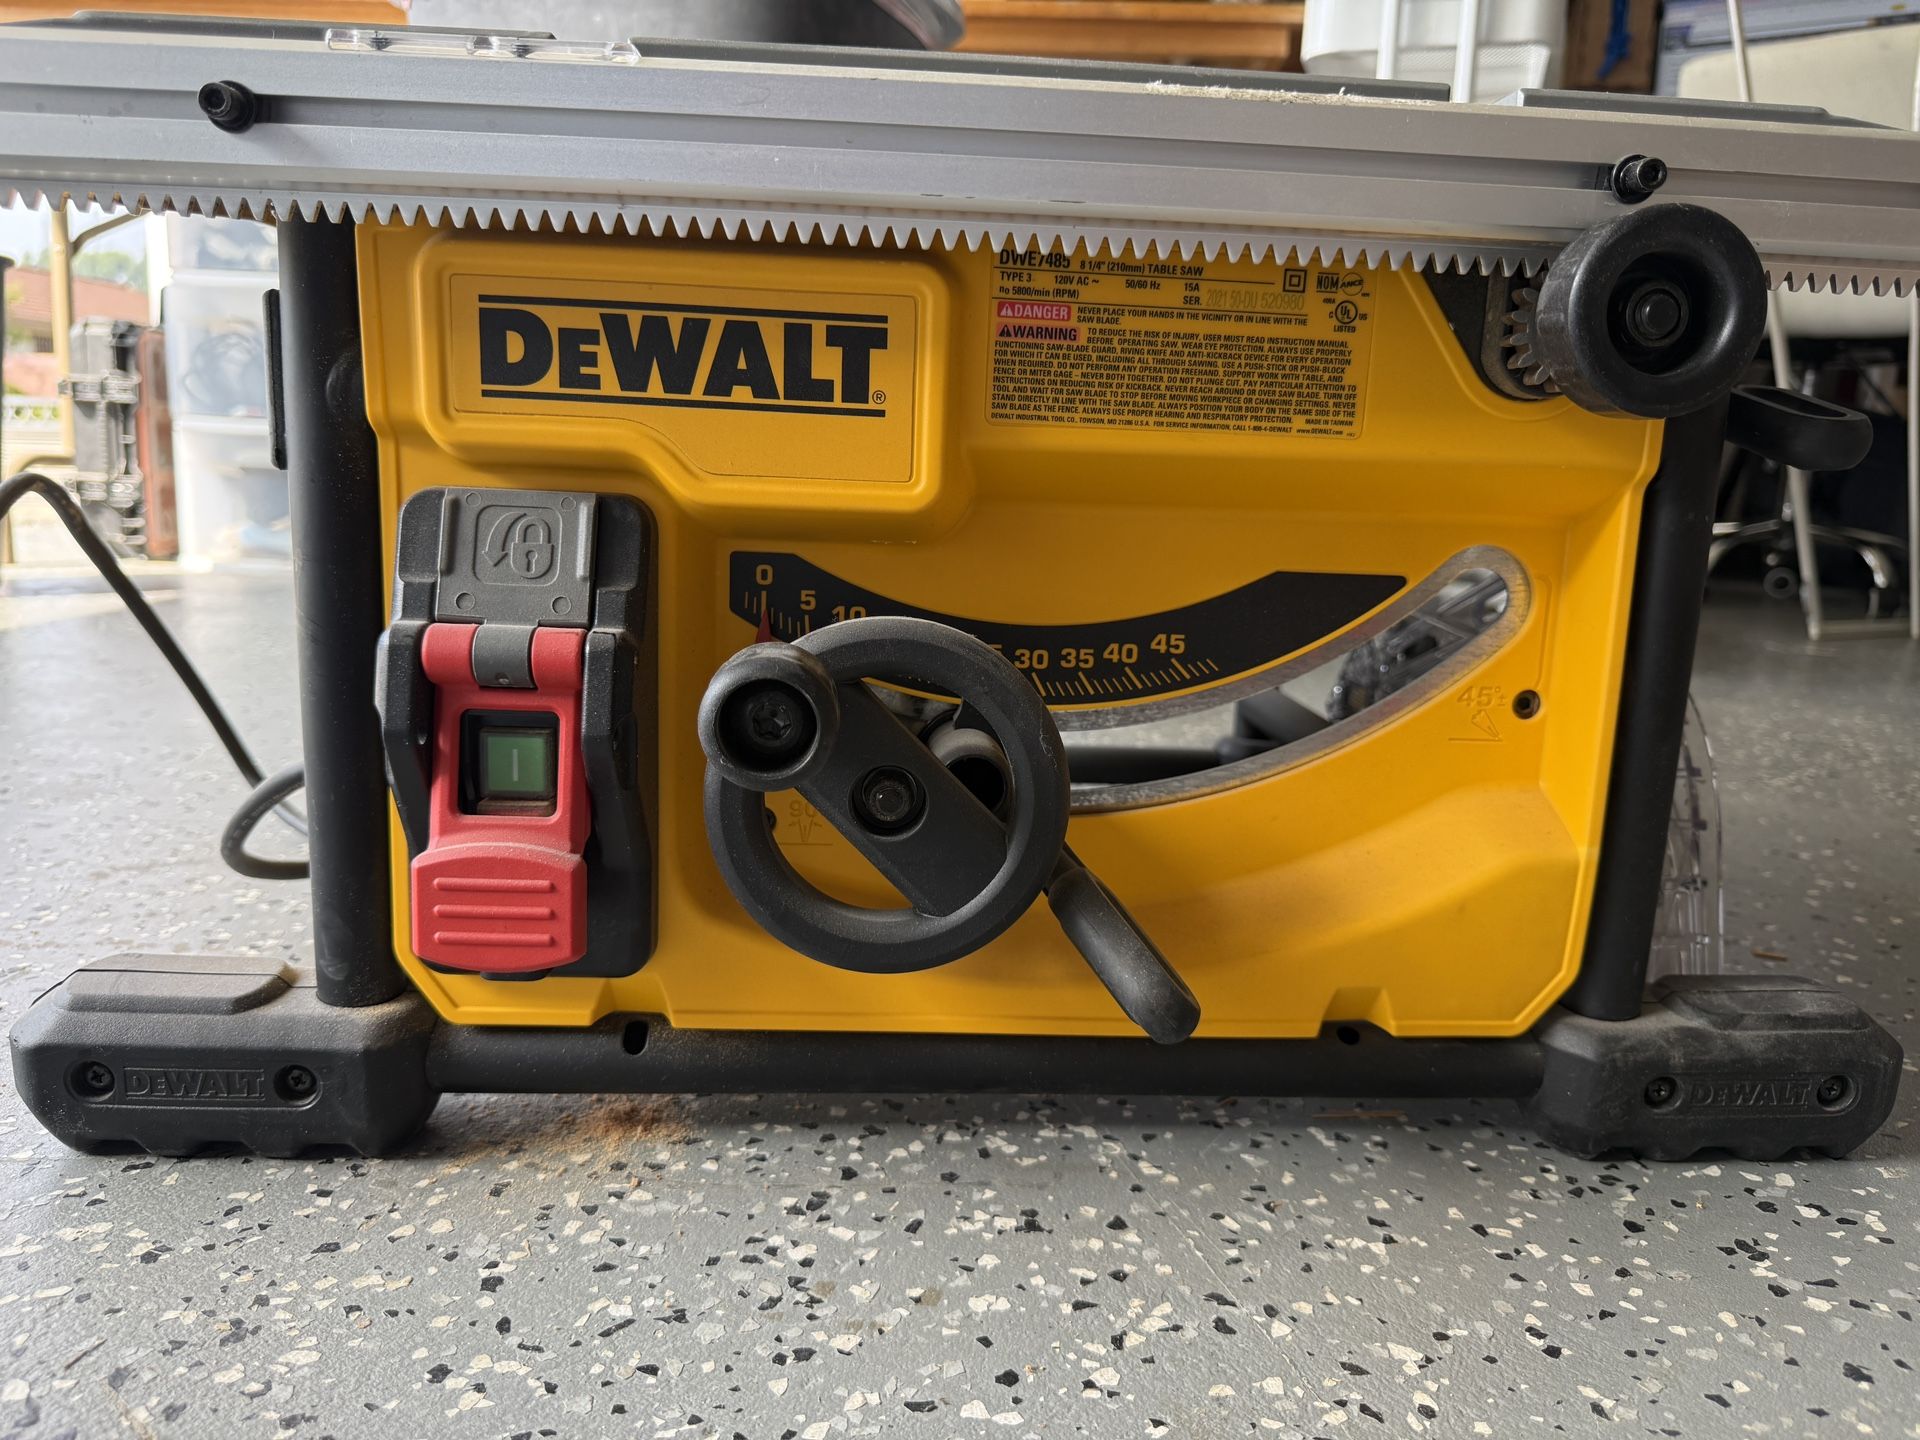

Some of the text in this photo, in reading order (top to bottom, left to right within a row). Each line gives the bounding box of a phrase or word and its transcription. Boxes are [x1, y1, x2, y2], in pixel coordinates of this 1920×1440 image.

[999, 271, 1031, 282] TYPE 3
[1079, 259, 1085, 269] 8
[1106, 261, 1145, 274] (210mm)
[1147, 263, 1177, 275] TABLE
[1179, 265, 1203, 276] SAW
[1054, 274, 1089, 286] 120V AC
[1125, 279, 1160, 290] 50/60 Hz
[1184, 281, 1199, 292] 15A
[1316, 275, 1339, 290] NOM
[1011, 285, 1050, 297] 5800/min
[1052, 287, 1079, 298] (RPM)
[1182, 295, 1202, 305] SER.
[1206, 288, 1227, 307] 2021
[1260, 291, 1305, 311] 520980
[1014, 303, 1068, 319] DANGER
[1076, 315, 1095, 323] SAW
[1077, 305, 1292, 324] NEVER PLACE YOUR HANDS VICINITY LINE WITH
[1012, 325, 1077, 341] WARNING
[1098, 327, 1349, 348] REDUCE RISK USER MUST READ INSTRUCTION MANUAL
[1333, 324, 1355, 333] LISTED
[994, 340, 1351, 365] FUNCTIONING SAW-BLADE RIVING KNIFE ANTI-KICKBACK DEVICE EVERY OPERATION
[1086, 336, 1351, 357] BEFORE OPERATING WEAR ALWAYS PROPERLY
[993, 357, 1016, 366] WHEN
[1068, 361, 1084, 369] NOT
[1085, 362, 1120, 371] PERFORM
[1121, 364, 1137, 372] ANY
[1138, 365, 1180, 374] OPERATION
[1222, 369, 1255, 378] SUPPORT
[1256, 371, 1279, 379] WORK
[1280, 372, 1300, 380] WITH
[1009, 349, 1345, 374] WHICH CAN INCLUDING ALL THROUGH USE PUSH-STICK PUSH-BLOCK
[992, 375, 1045, 385] INSTRUCTIONS
[1059, 379, 1096, 388] REDUCING
[1097, 381, 1114, 389] RISK
[1164, 384, 1188, 392] NEVER
[1189, 385, 1213, 394] REACH
[1214, 386, 1245, 395] AROUND
[1257, 389, 1276, 397] OVER
[1277, 390, 1295, 398] SAW
[1323, 392, 1343, 400] TURN
[993, 366, 1346, 391] FENCE MITER GAGE NEVER BOTH NOT PLUNGE PAY PARTICULAR ATTENTION
[991, 393, 1016, 401] STAND
[1017, 394, 1050, 403] DIRECTLY
[1060, 396, 1077, 404] LINE
[1078, 397, 1097, 405] WITH
[1098, 398, 1112, 406] THE
[1113, 399, 1130, 407] SAW
[1157, 401, 1188, 410] ALWAYS
[1188, 403, 1222, 411] POSITION
[1223, 404, 1243, 412] YOUR
[1244, 405, 1264, 413] BODY
[1278, 407, 1291, 415] THE
[992, 384, 1356, 409] TOOL AND WAIT FOR SAW BLADE STOP BEFORE MOVING WORKPIECE CHANGING NEVER
[991, 401, 1008, 409] SAW
[1008, 402, 1031, 411] BLADE
[1043, 404, 1056, 412] THE
[1081, 406, 1110, 415] ALWAYS
[1126, 408, 1153, 417] PROPER
[1154, 410, 1185, 418] HEARING
[1186, 411, 1201, 419] AND
[1202, 412, 1248, 421] RESPIRATORY
[1015, 413, 1049, 421] INDUSTRIAL
[756, 564, 774, 586] 0
[800, 590, 817, 611] 5
[1102, 643, 1138, 664] 40
[1150, 634, 1185, 654] 45
[1014, 649, 1049, 670] 30
[1060, 648, 1095, 668] 35
